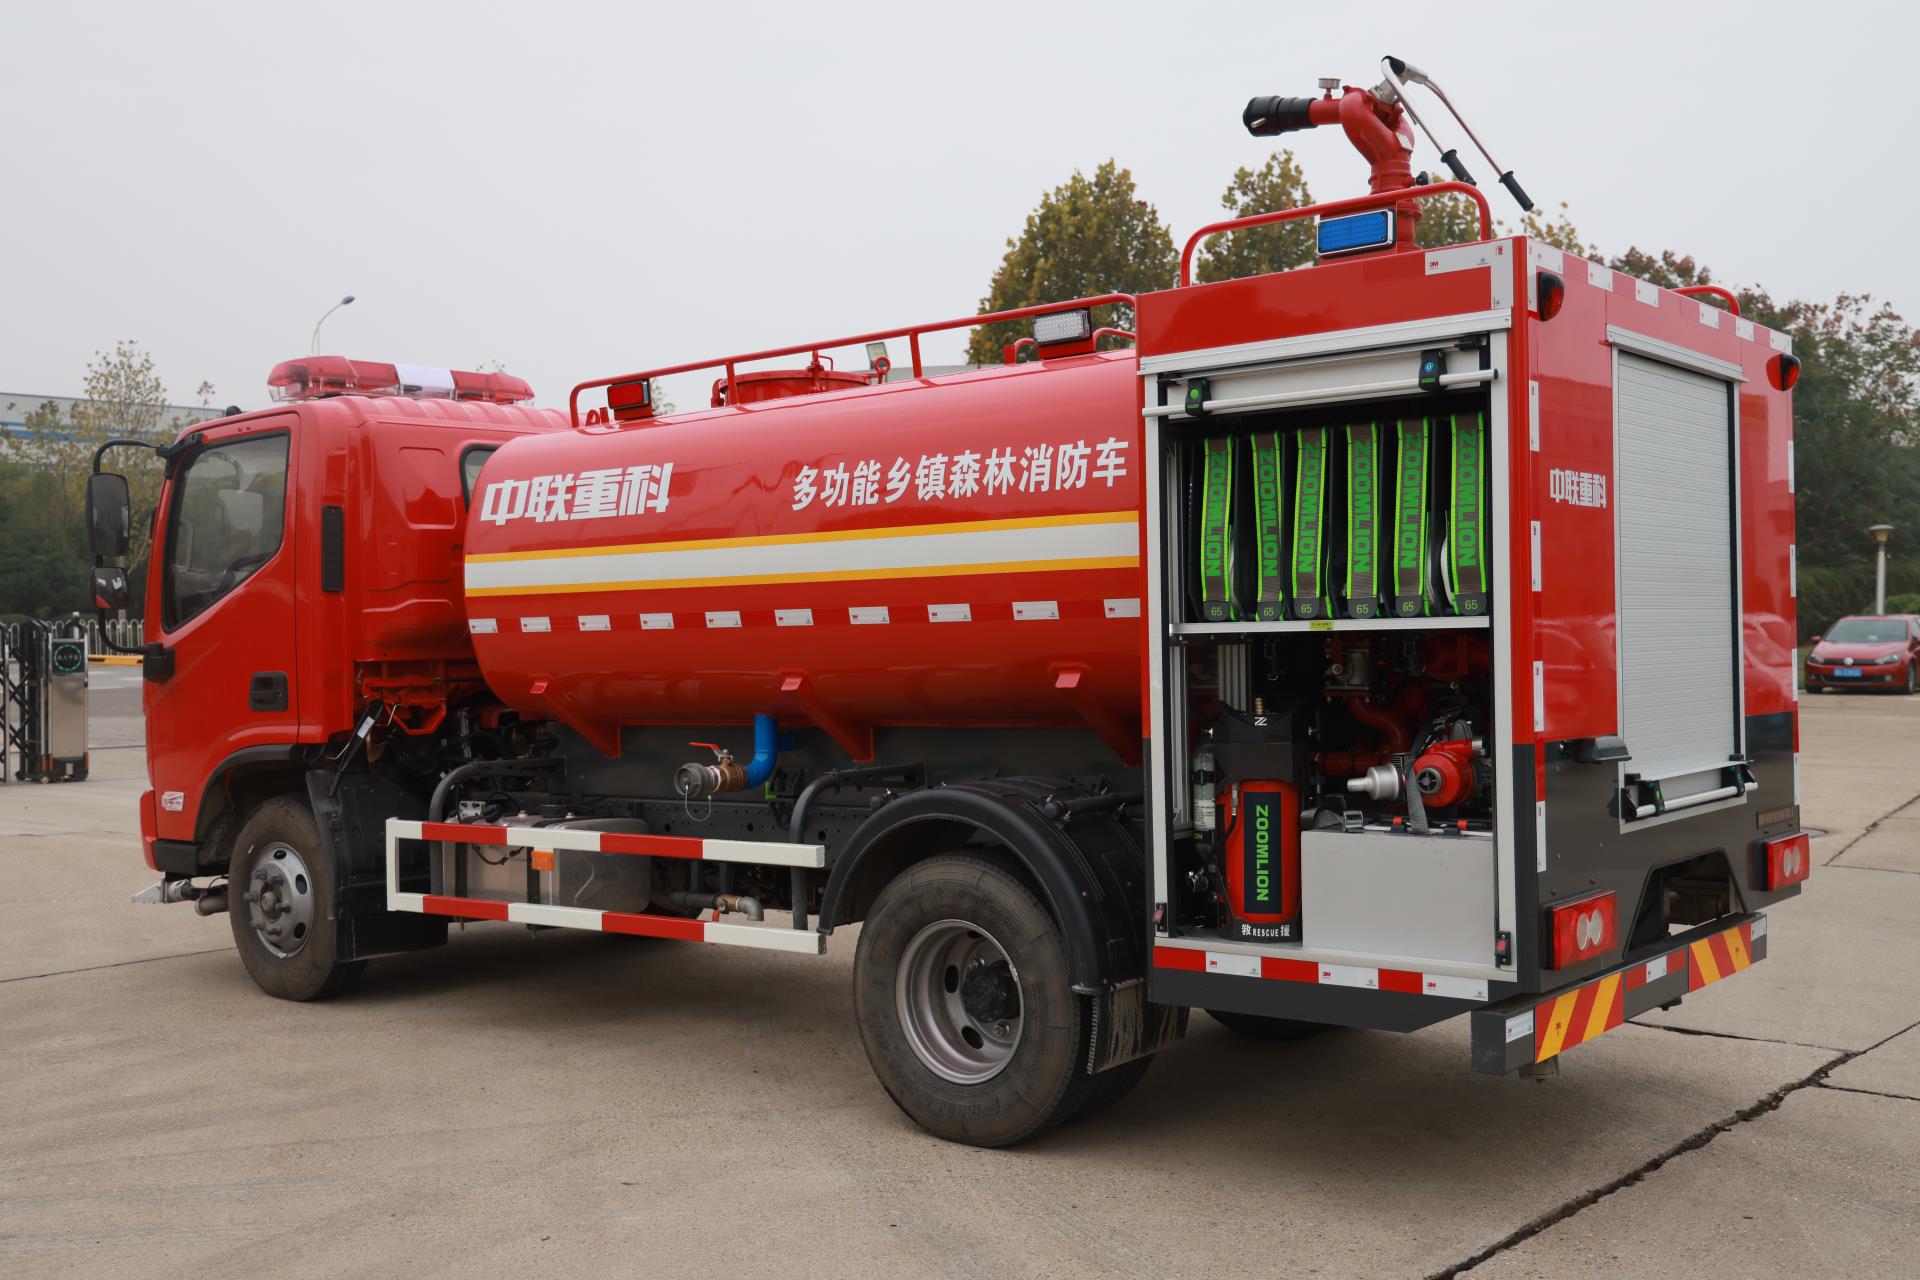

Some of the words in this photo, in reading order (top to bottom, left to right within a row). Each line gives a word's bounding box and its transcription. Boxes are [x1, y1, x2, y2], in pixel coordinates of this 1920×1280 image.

[480, 462, 674, 526] 中联重科
[792, 437, 1129, 511] 多功能乡镇森林消防车
[1354, 439, 1370, 572] ZOOMLION
[1400, 432, 1421, 568] ZOOMLION
[1458, 429, 1476, 567] ZOOMLION
[1550, 469, 1606, 508] 中联重科
[1206, 451, 1226, 576] ZOOMLION
[1259, 449, 1278, 576] ZOOMLION
[1299, 442, 1320, 573] ZOOMLION
[1211, 607, 1222, 616] 65
[1263, 607, 1274, 617] 65
[1301, 604, 1312, 614] 65
[1356, 604, 1368, 613] 65
[1402, 602, 1414, 612] 65
[1465, 600, 1478, 610] 65
[1256, 805, 1269, 901] ZOOMLION
[1252, 929, 1279, 937] RESCUE
